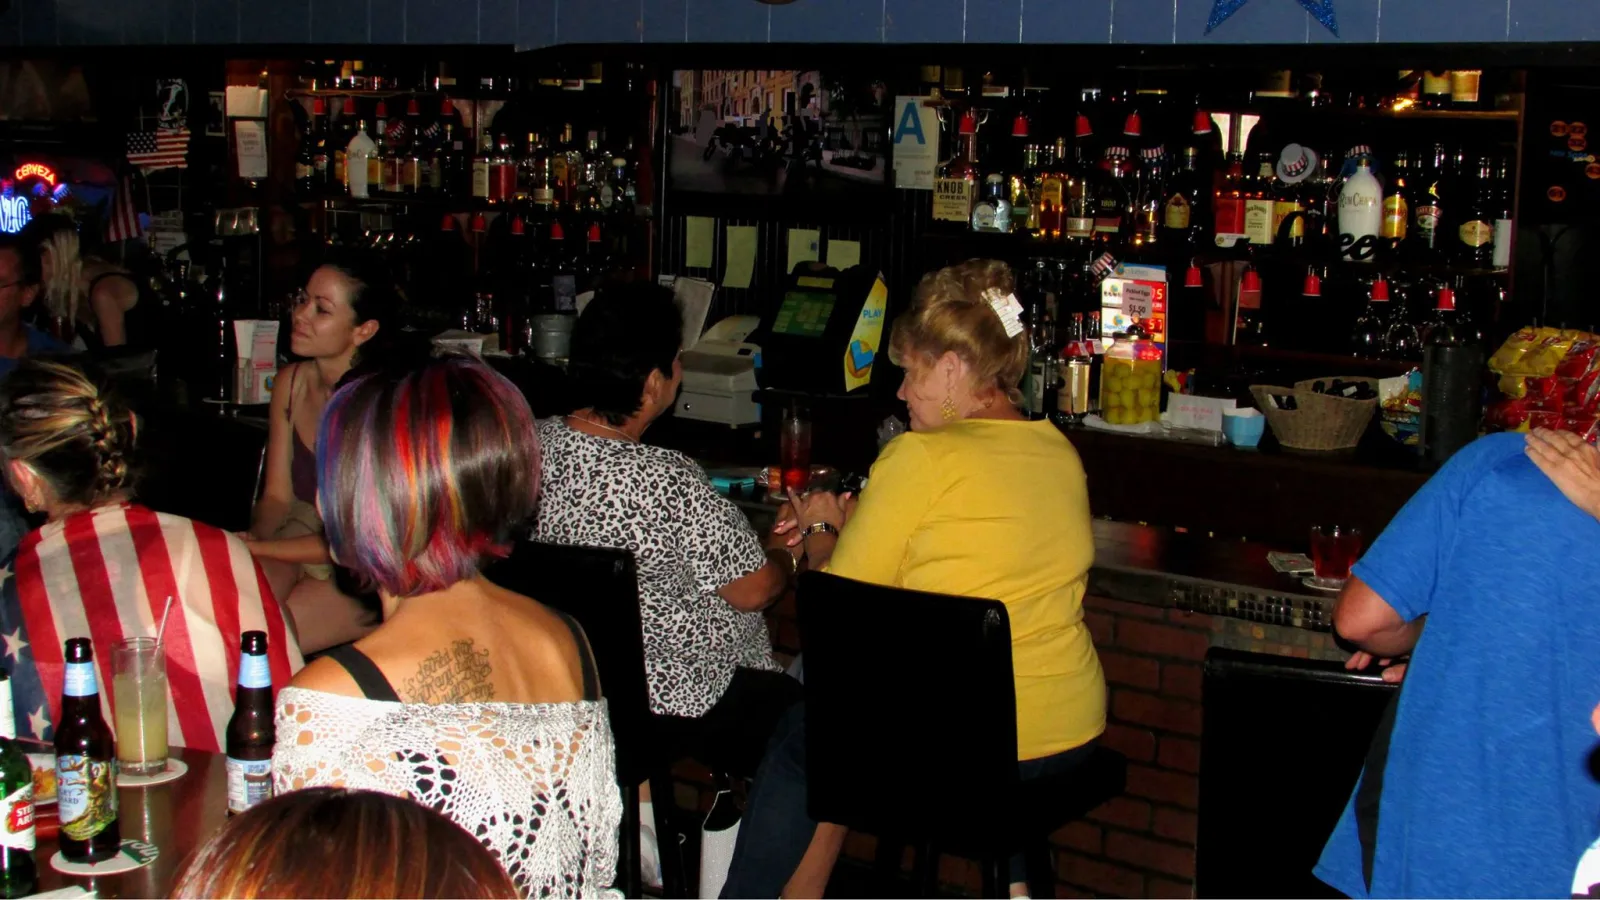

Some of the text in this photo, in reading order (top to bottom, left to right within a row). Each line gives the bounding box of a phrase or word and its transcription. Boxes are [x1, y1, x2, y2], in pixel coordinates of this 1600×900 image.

[894, 102, 925, 144] A
[16, 163, 55, 186] CERVEZA
[937, 181, 964, 194] KNOB
[863, 308, 882, 319] PLAY
